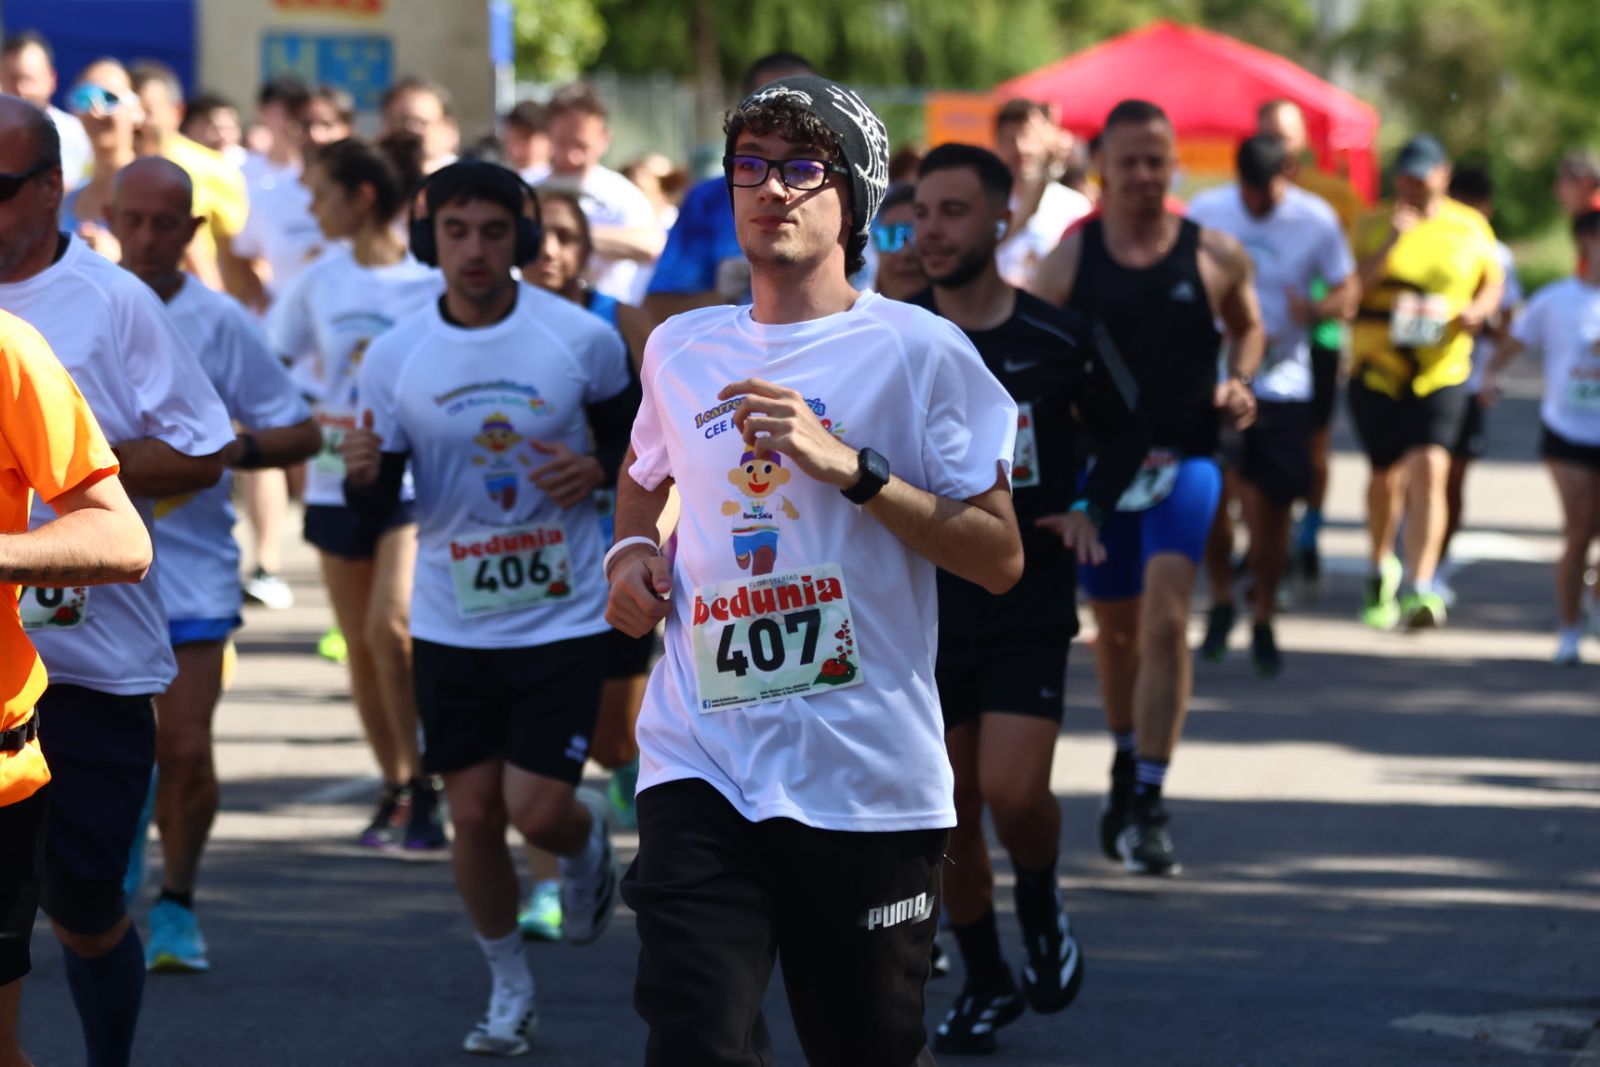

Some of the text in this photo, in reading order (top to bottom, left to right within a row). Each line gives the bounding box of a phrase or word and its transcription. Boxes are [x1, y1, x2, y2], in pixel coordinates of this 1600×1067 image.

[705, 420, 728, 439] CEE
[449, 528, 564, 562] bedunia
[473, 550, 551, 593] 406
[693, 575, 843, 627] bedunia
[716, 608, 821, 678] 407
[868, 892, 927, 931] PUMA
